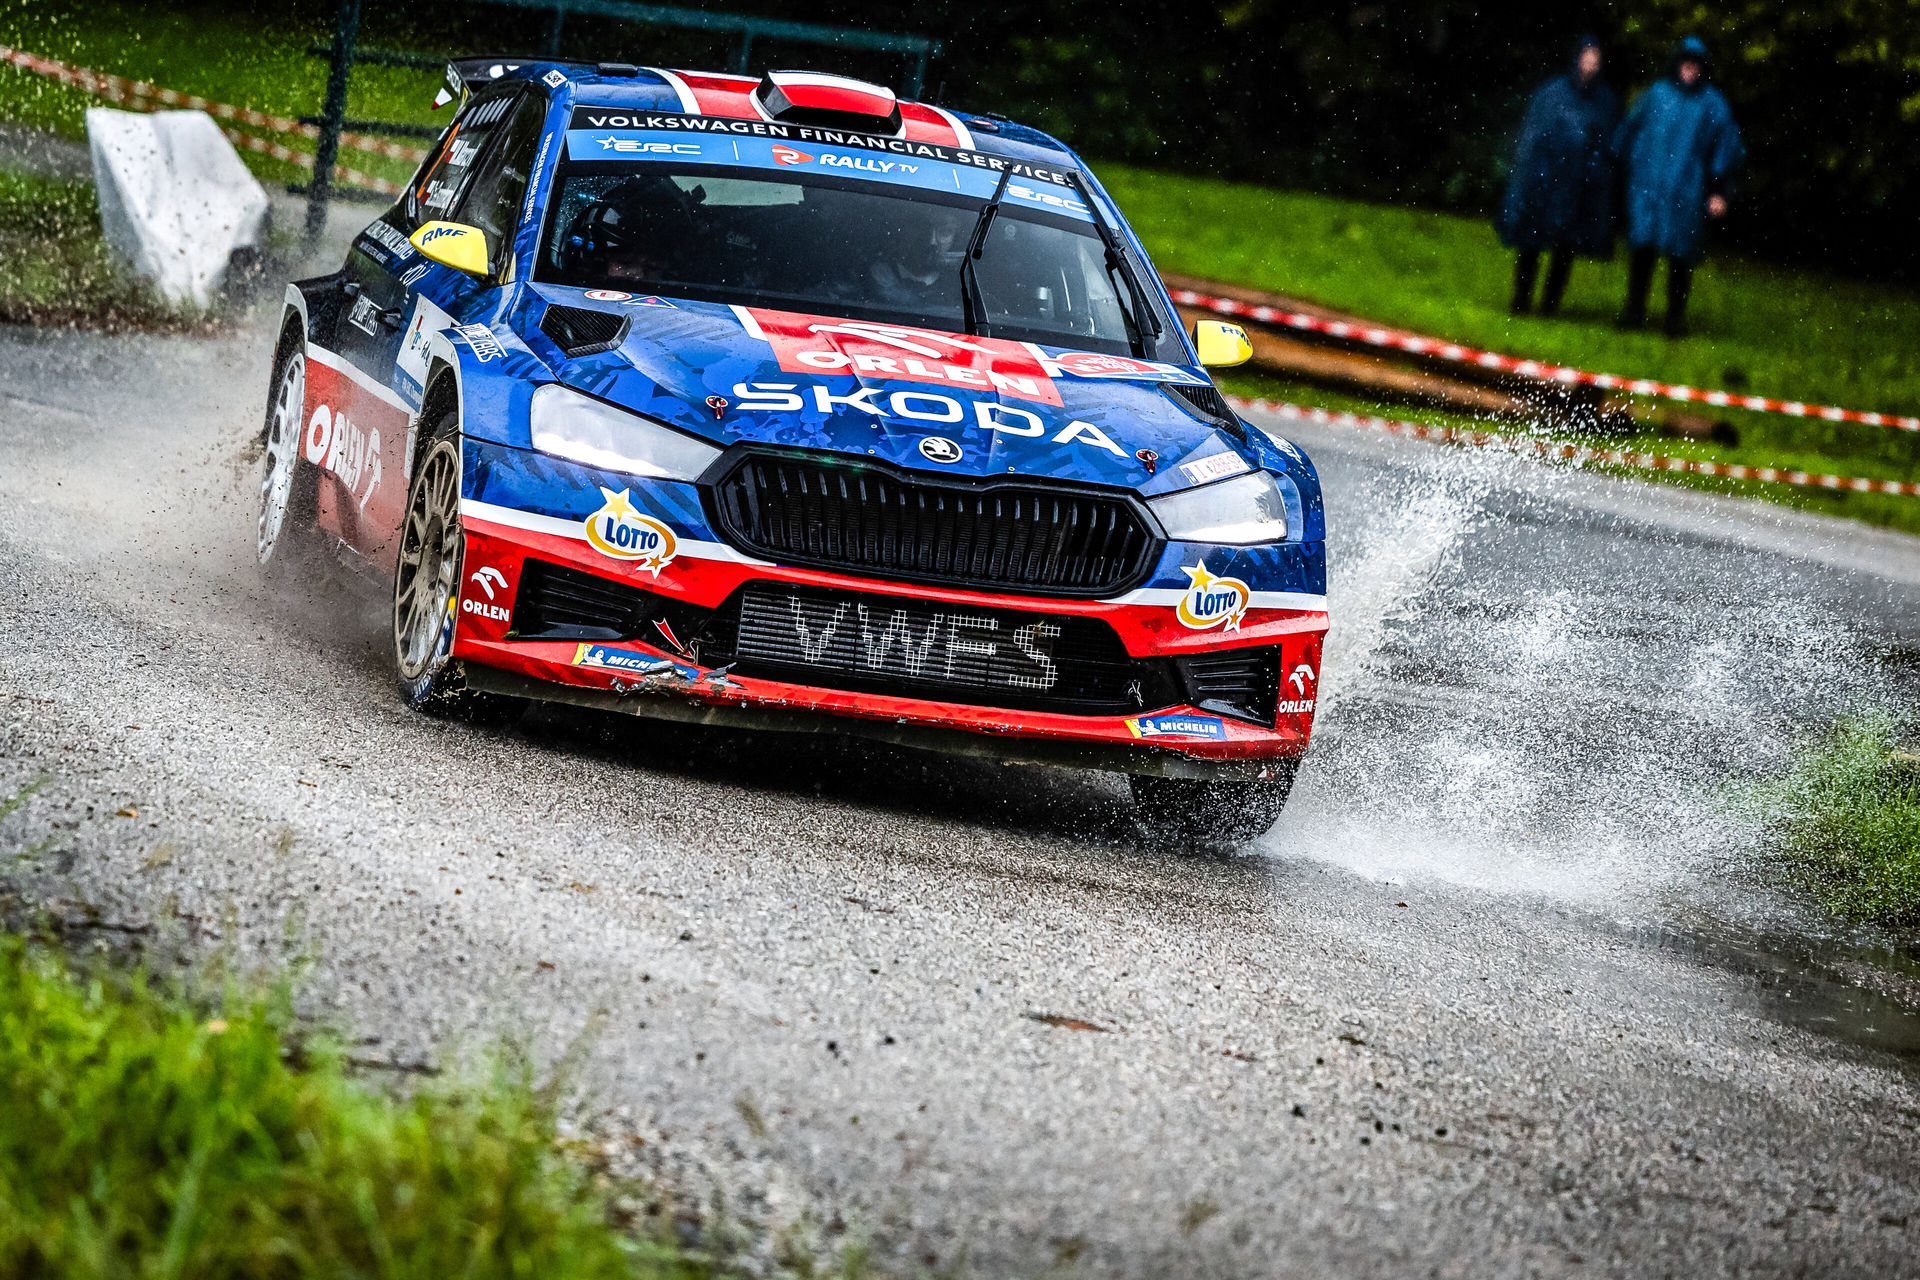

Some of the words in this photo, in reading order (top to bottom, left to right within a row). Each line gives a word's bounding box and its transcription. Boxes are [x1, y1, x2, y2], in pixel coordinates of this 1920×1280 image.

[587, 115, 789, 137] VOLKSWAGEN
[800, 128, 950, 161] FINANCIAL
[613, 139, 703, 155] ERC
[1007, 184, 1091, 214] ERC
[421, 227, 468, 247] RMF
[795, 351, 1042, 396] ORLEN
[604, 516, 659, 550] LOTTO
[462, 598, 511, 622] ORLEN
[1194, 590, 1237, 616] LOTTO
[787, 595, 1061, 693] VWFS
[605, 655, 689, 676] MICH
[1278, 699, 1314, 714] ORLEN
[1159, 721, 1218, 735] MICHELIN
